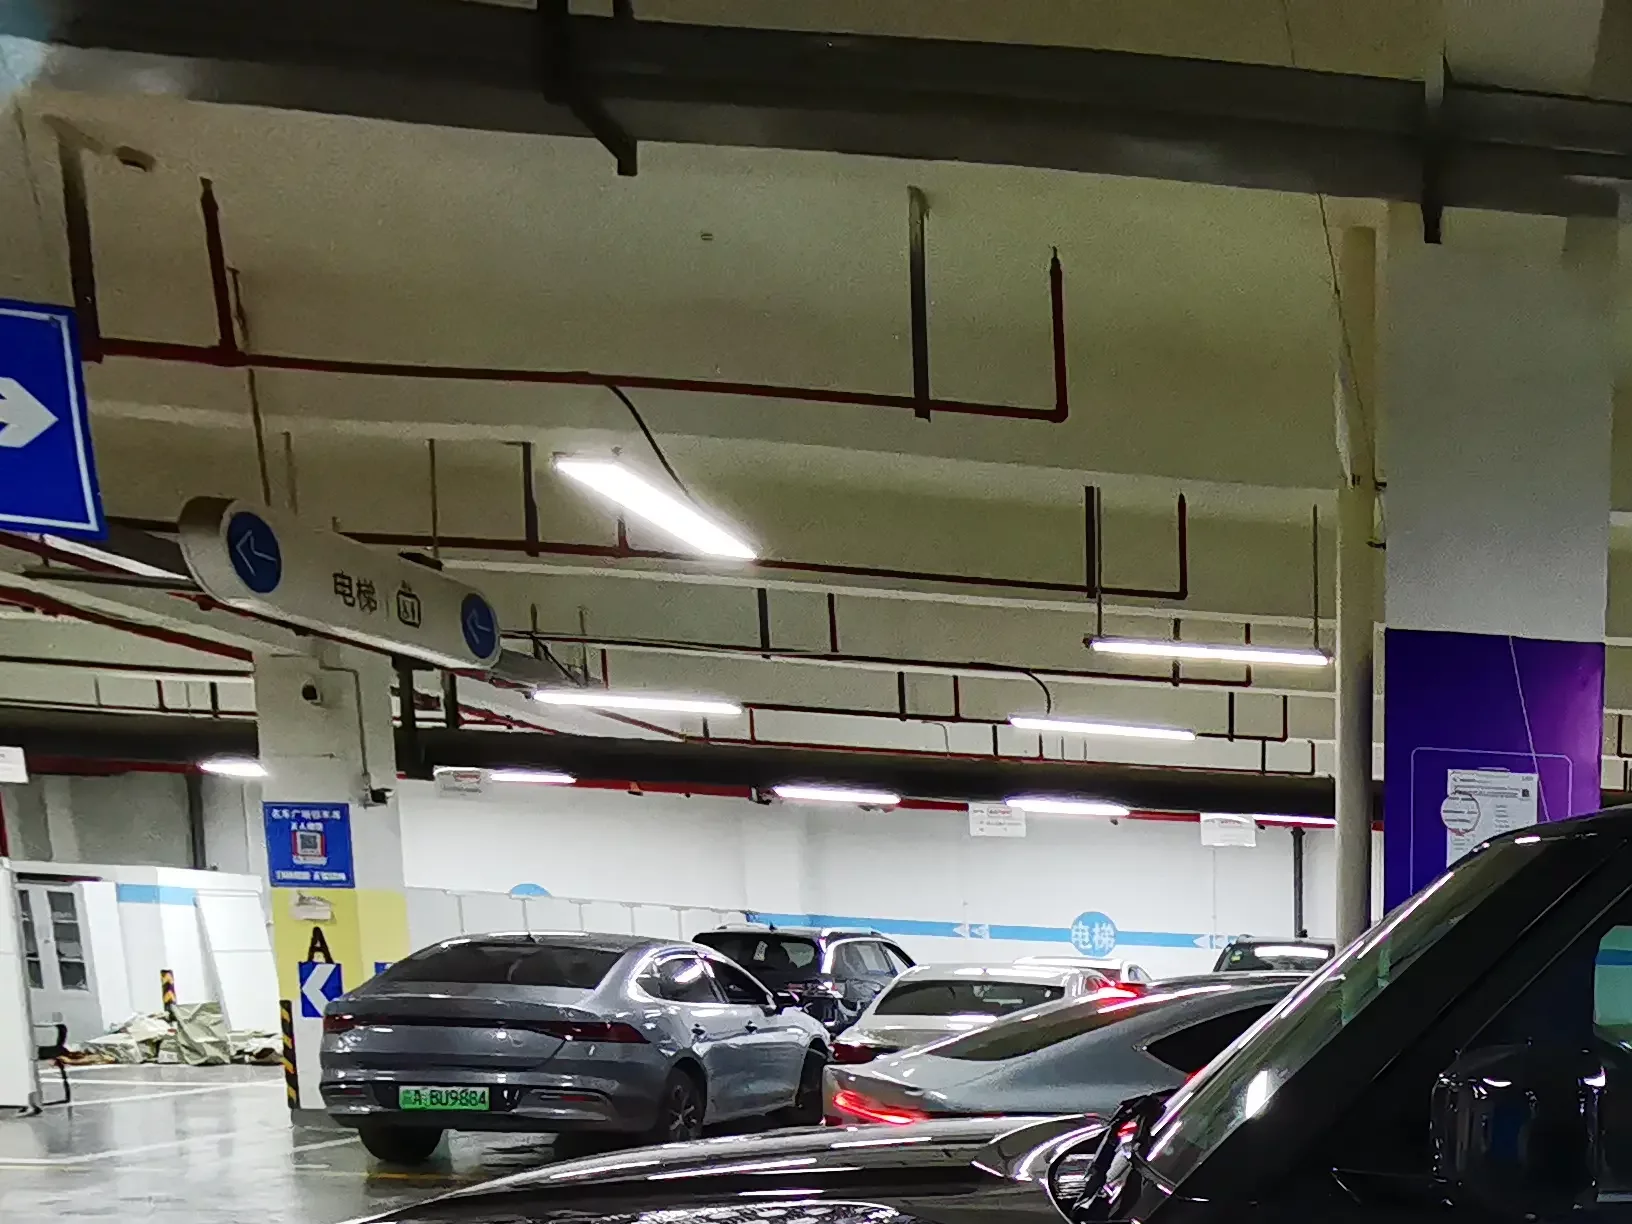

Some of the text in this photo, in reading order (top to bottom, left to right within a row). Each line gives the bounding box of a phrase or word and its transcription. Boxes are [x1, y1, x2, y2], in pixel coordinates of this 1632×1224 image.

[332, 569, 378, 615] 电梯
[307, 926, 335, 963] A
[1071, 920, 1116, 954] 电梯
